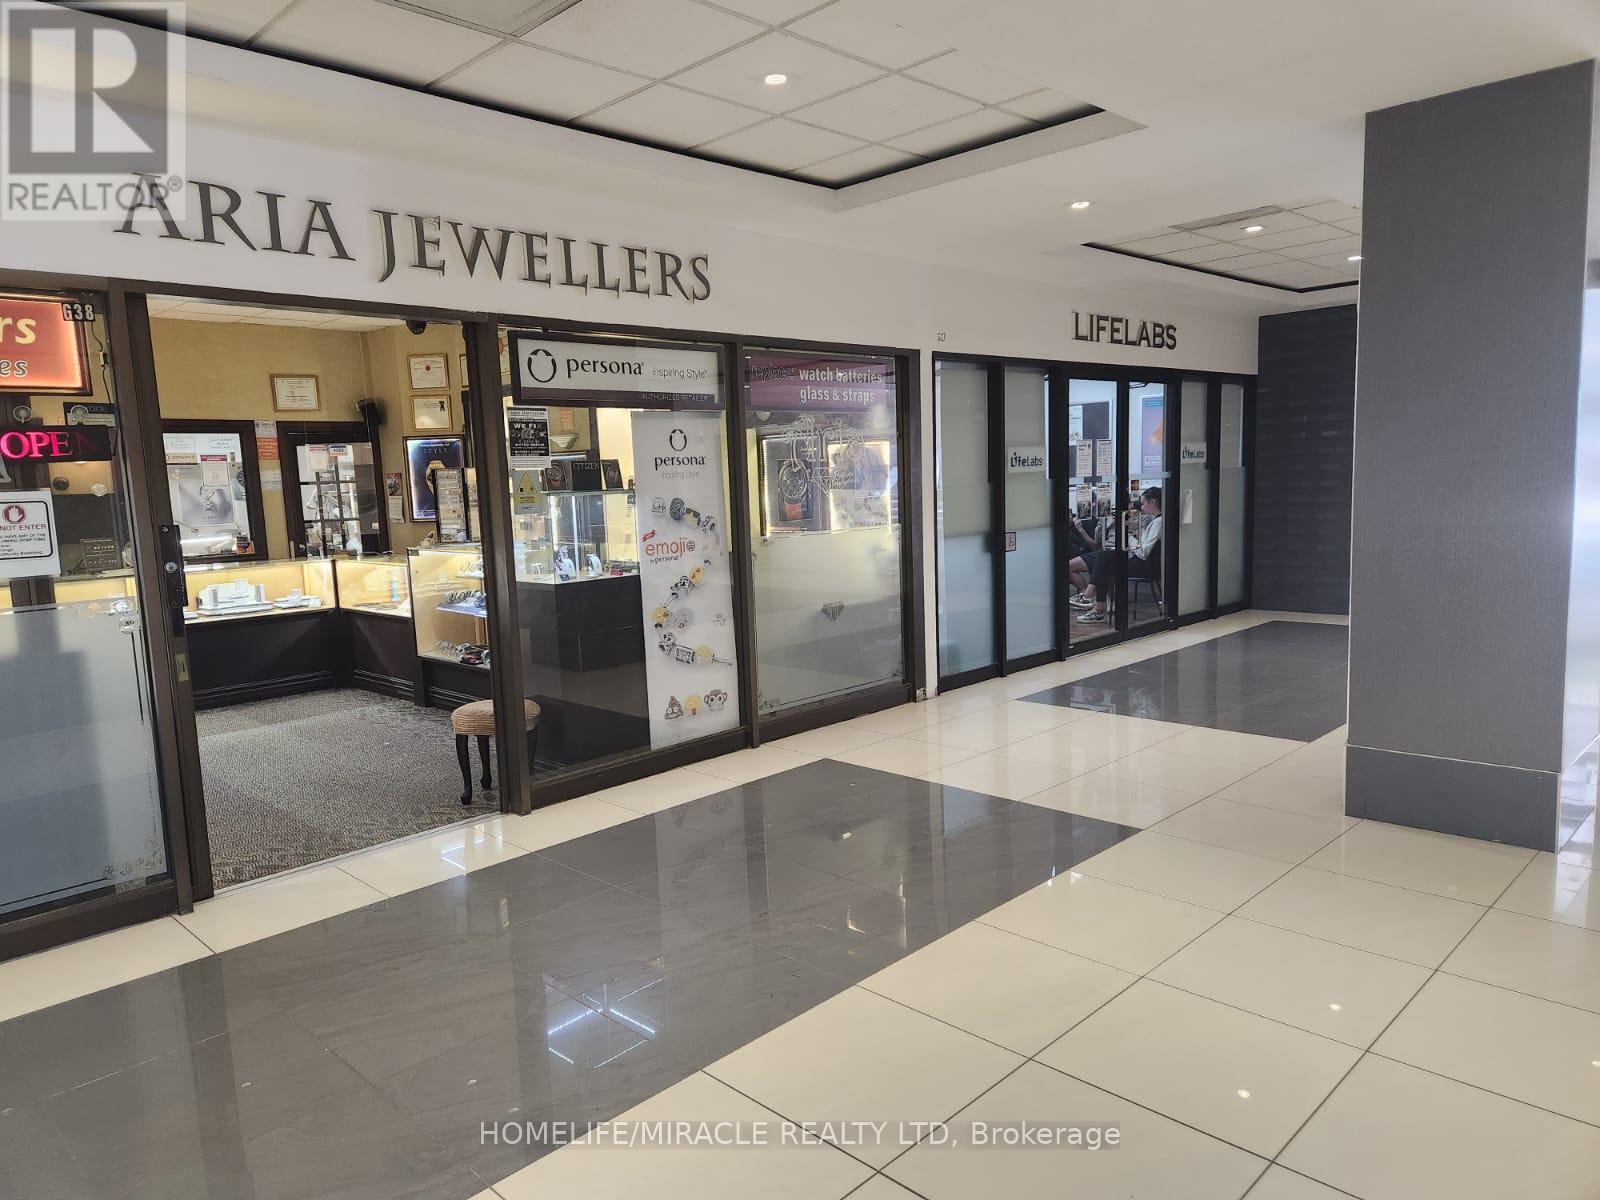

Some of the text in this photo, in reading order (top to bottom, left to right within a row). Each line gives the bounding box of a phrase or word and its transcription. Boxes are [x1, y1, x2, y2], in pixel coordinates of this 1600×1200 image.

[112, 171, 712, 305] ARIA JEWELLERS
[63, 304, 94, 320] G38
[1072, 311, 1178, 350] LIFELABS
[799, 367, 833, 383] watch
[800, 386, 875, 405] glass & straps
[1010, 451, 1044, 468] LifeLabs
[645, 537, 687, 557] emoji
